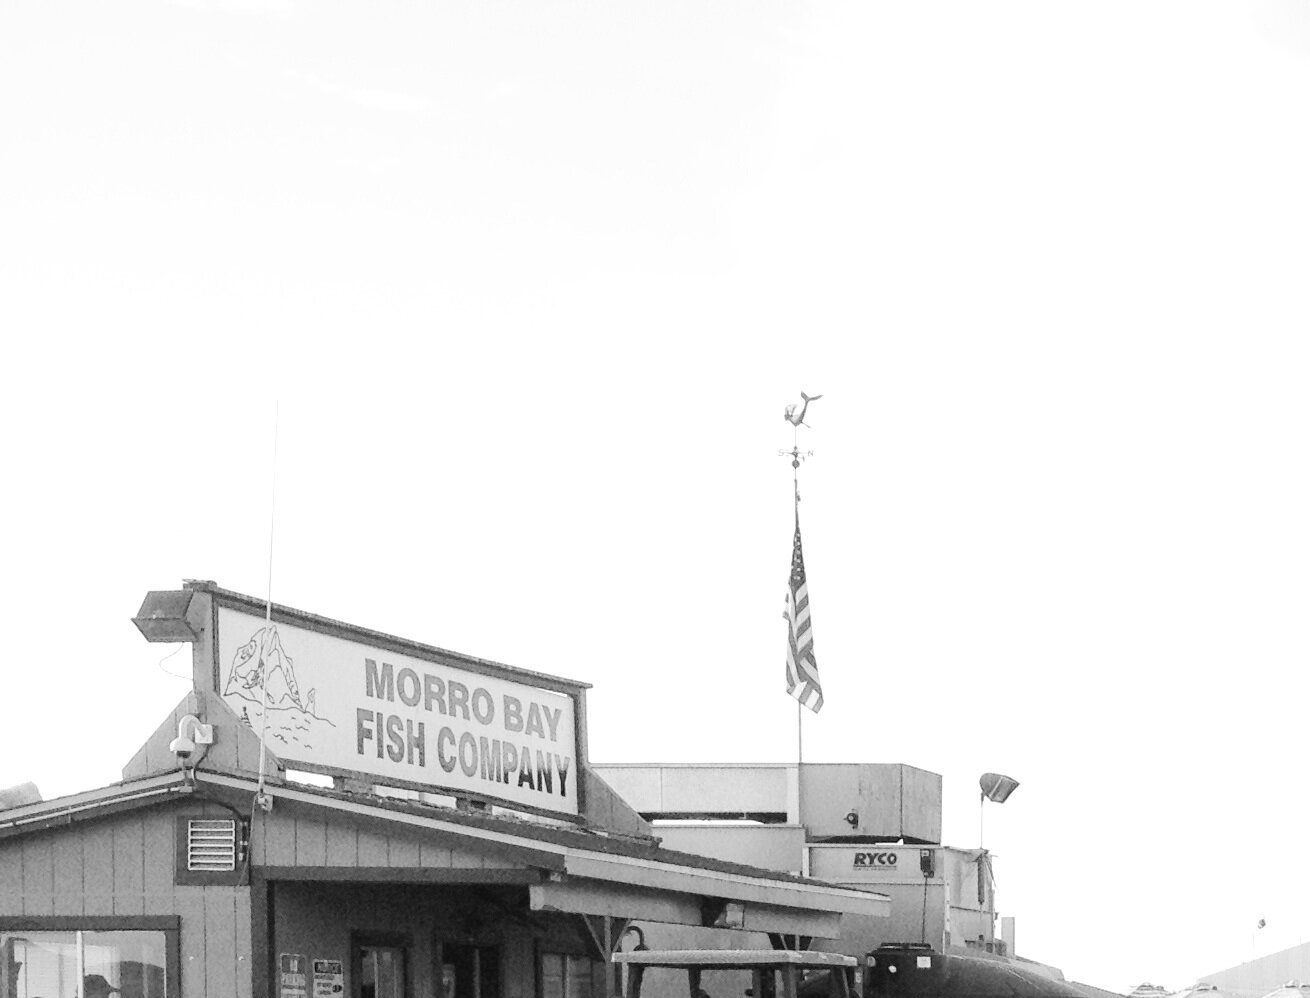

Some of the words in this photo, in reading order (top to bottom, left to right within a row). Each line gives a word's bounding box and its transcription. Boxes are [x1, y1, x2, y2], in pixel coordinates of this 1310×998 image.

[365, 658, 495, 726] MORRO
[503, 694, 563, 743] BAY
[356, 707, 426, 768] FISH
[437, 727, 571, 798] COMPANY
[854, 852, 897, 865] RYCO
